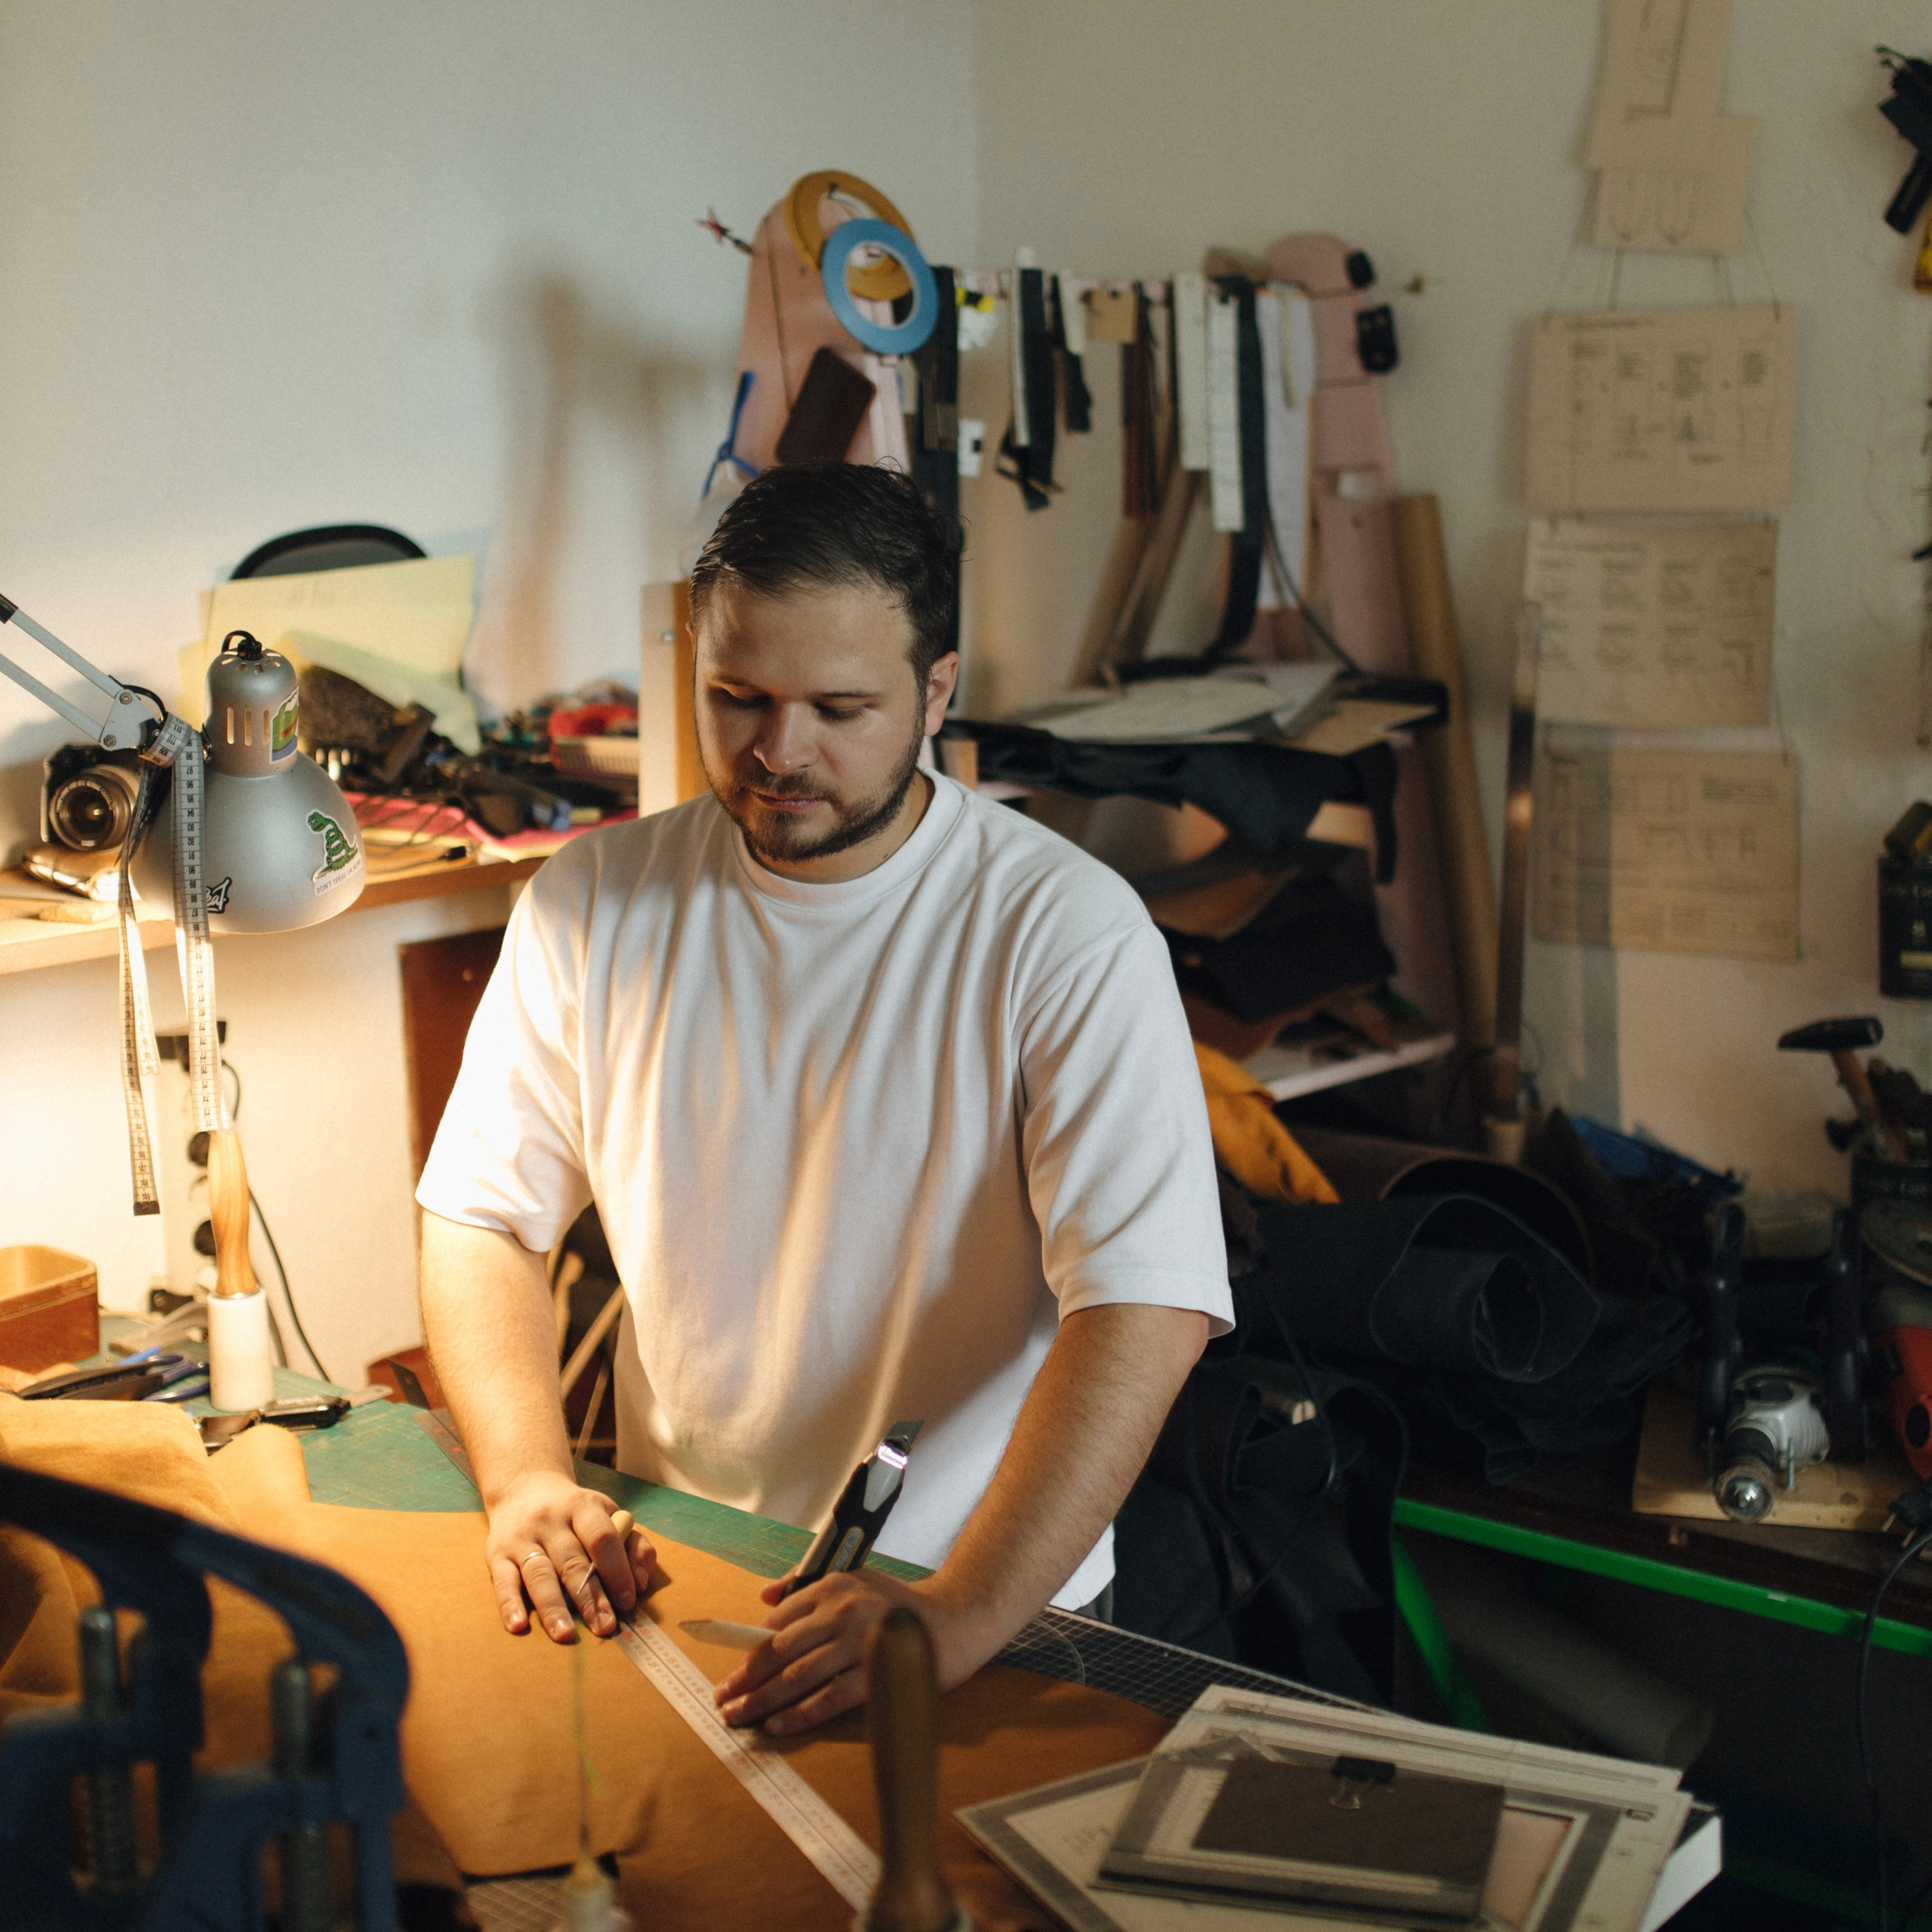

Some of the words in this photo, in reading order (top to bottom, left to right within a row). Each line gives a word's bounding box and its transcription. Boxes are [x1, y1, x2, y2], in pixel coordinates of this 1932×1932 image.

[174, 724, 183, 734] 111
[167, 735, 177, 746] 110
[159, 747, 169, 756] 109
[316, 881, 331, 894] DON'T
[333, 872, 346, 885] TREAD
